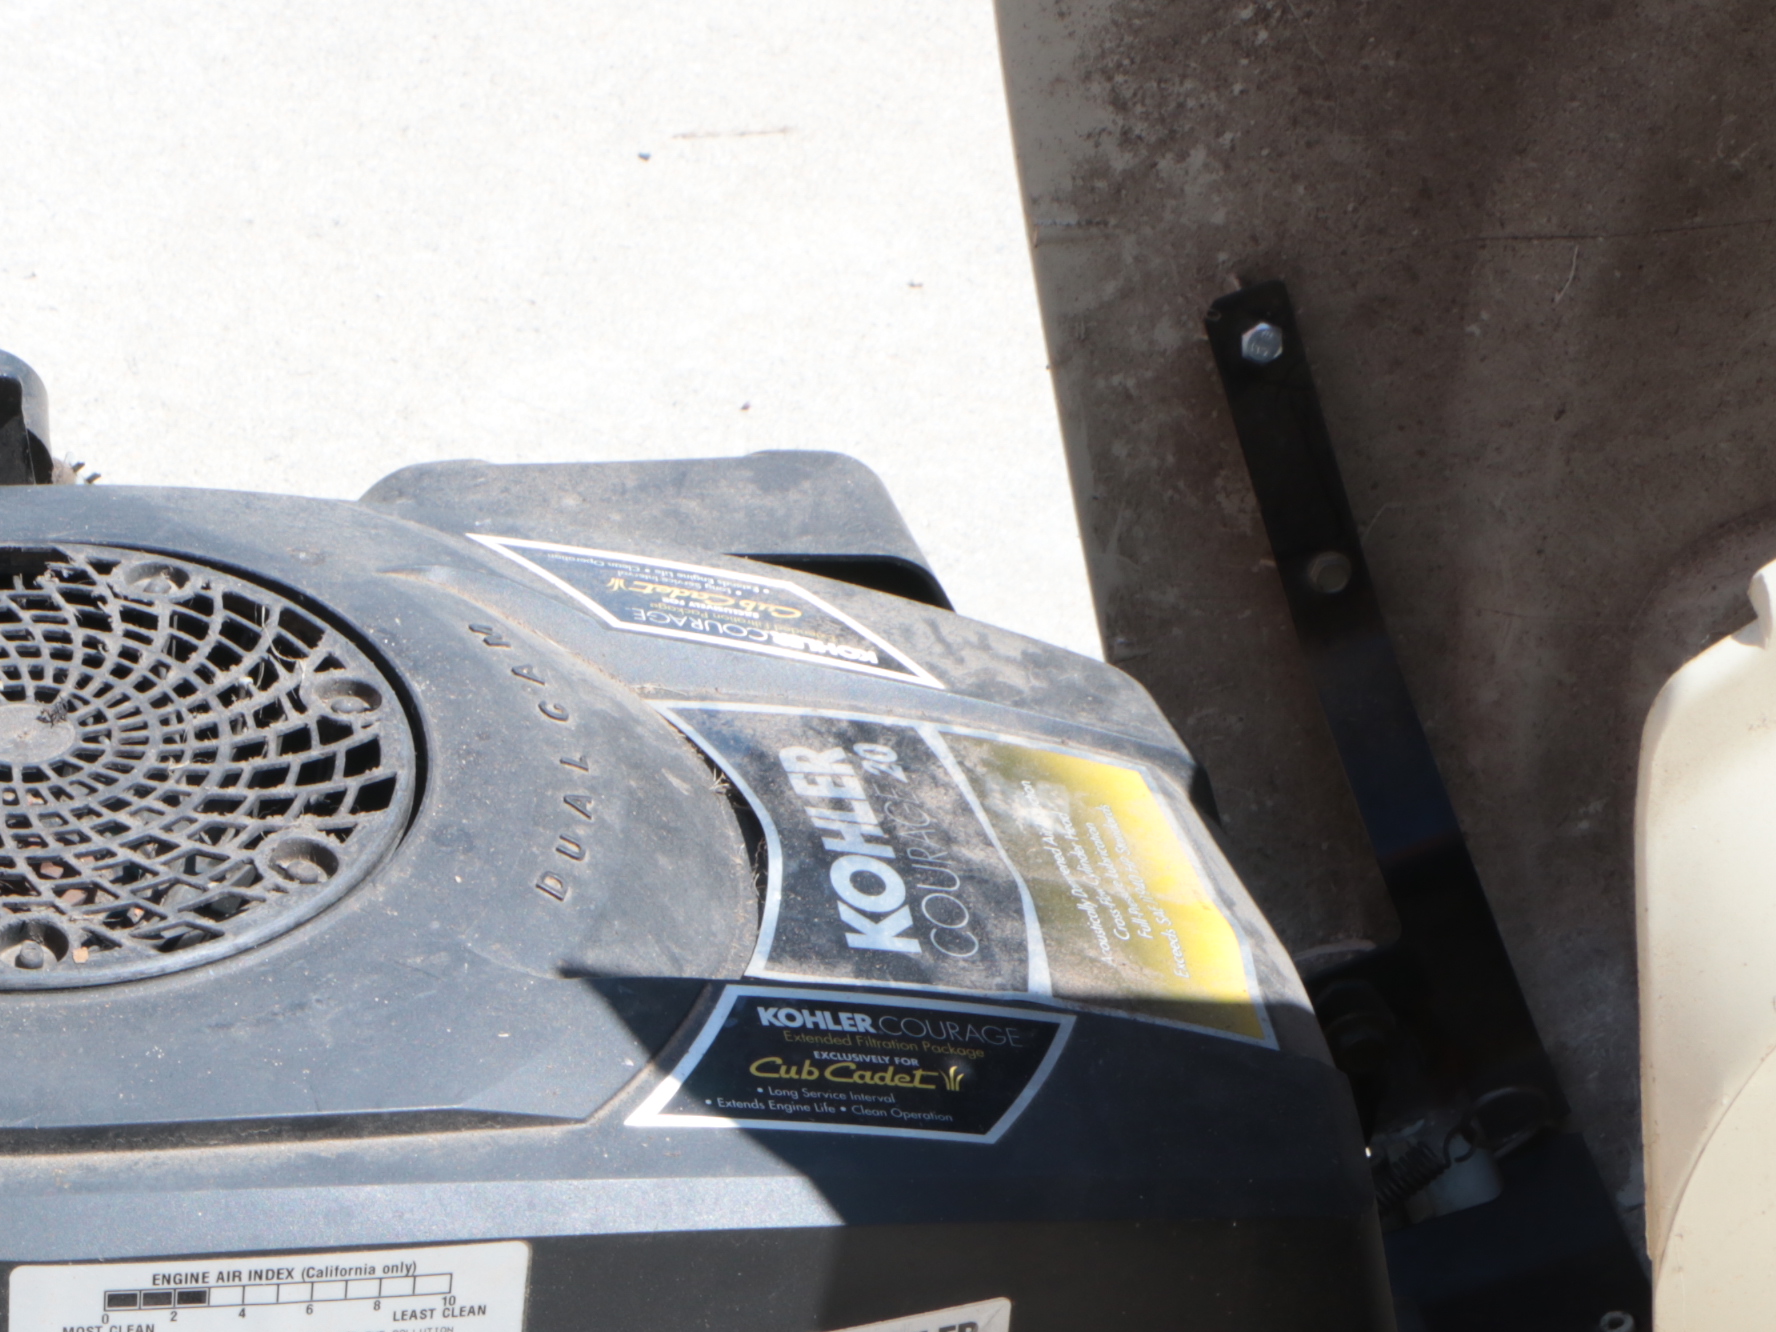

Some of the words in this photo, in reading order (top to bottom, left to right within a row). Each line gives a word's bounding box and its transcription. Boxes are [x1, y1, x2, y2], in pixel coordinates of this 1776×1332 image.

[628, 580, 735, 606] Cadet
[630, 607, 768, 642] COURAGE
[739, 599, 802, 619] Cub
[769, 631, 878, 664] KOHLER
[853, 743, 908, 783] 20
[536, 754, 593, 902] DUAL
[779, 746, 922, 953] KOHLER
[874, 782, 979, 957] COURAGE
[1161, 928, 1190, 978] Exceeds
[757, 1006, 877, 1034] KOHLER
[878, 1015, 1024, 1048] COURAGE
[784, 1030, 852, 1047] Extended
[856, 1035, 919, 1052] Filtration
[922, 1040, 984, 1060] Package
[813, 1050, 891, 1065] EXCLUSIVELY
[894, 1056, 920, 1067] FOR
[749, 1057, 820, 1080] Cub
[824, 1062, 940, 1089] Cadet
[717, 1098, 765, 1110] Extends
[769, 1100, 811, 1115] Engine
[814, 1102, 836, 1114] Life
[851, 1104, 887, 1117] Clean
[890, 1108, 953, 1123] Operation
[768, 1086, 798, 1100] Long
[802, 1088, 847, 1101] Service
[850, 1092, 895, 1104] Interval
[152, 1272, 210, 1286] ENGINE
[216, 1270, 242, 1283] AIR
[248, 1267, 295, 1282] INDEX
[302, 1263, 376, 1283] (California
[383, 1261, 417, 1277] only)
[102, 1314, 109, 1324] 0
[170, 1311, 178, 1322] 2
[238, 1308, 246, 1318] 4
[306, 1304, 313, 1315] 6
[374, 1301, 381, 1311] 8
[442, 1296, 456, 1307] 10
[393, 1309, 436, 1322] LEAST
[442, 1305, 487, 1318] CLEAN
